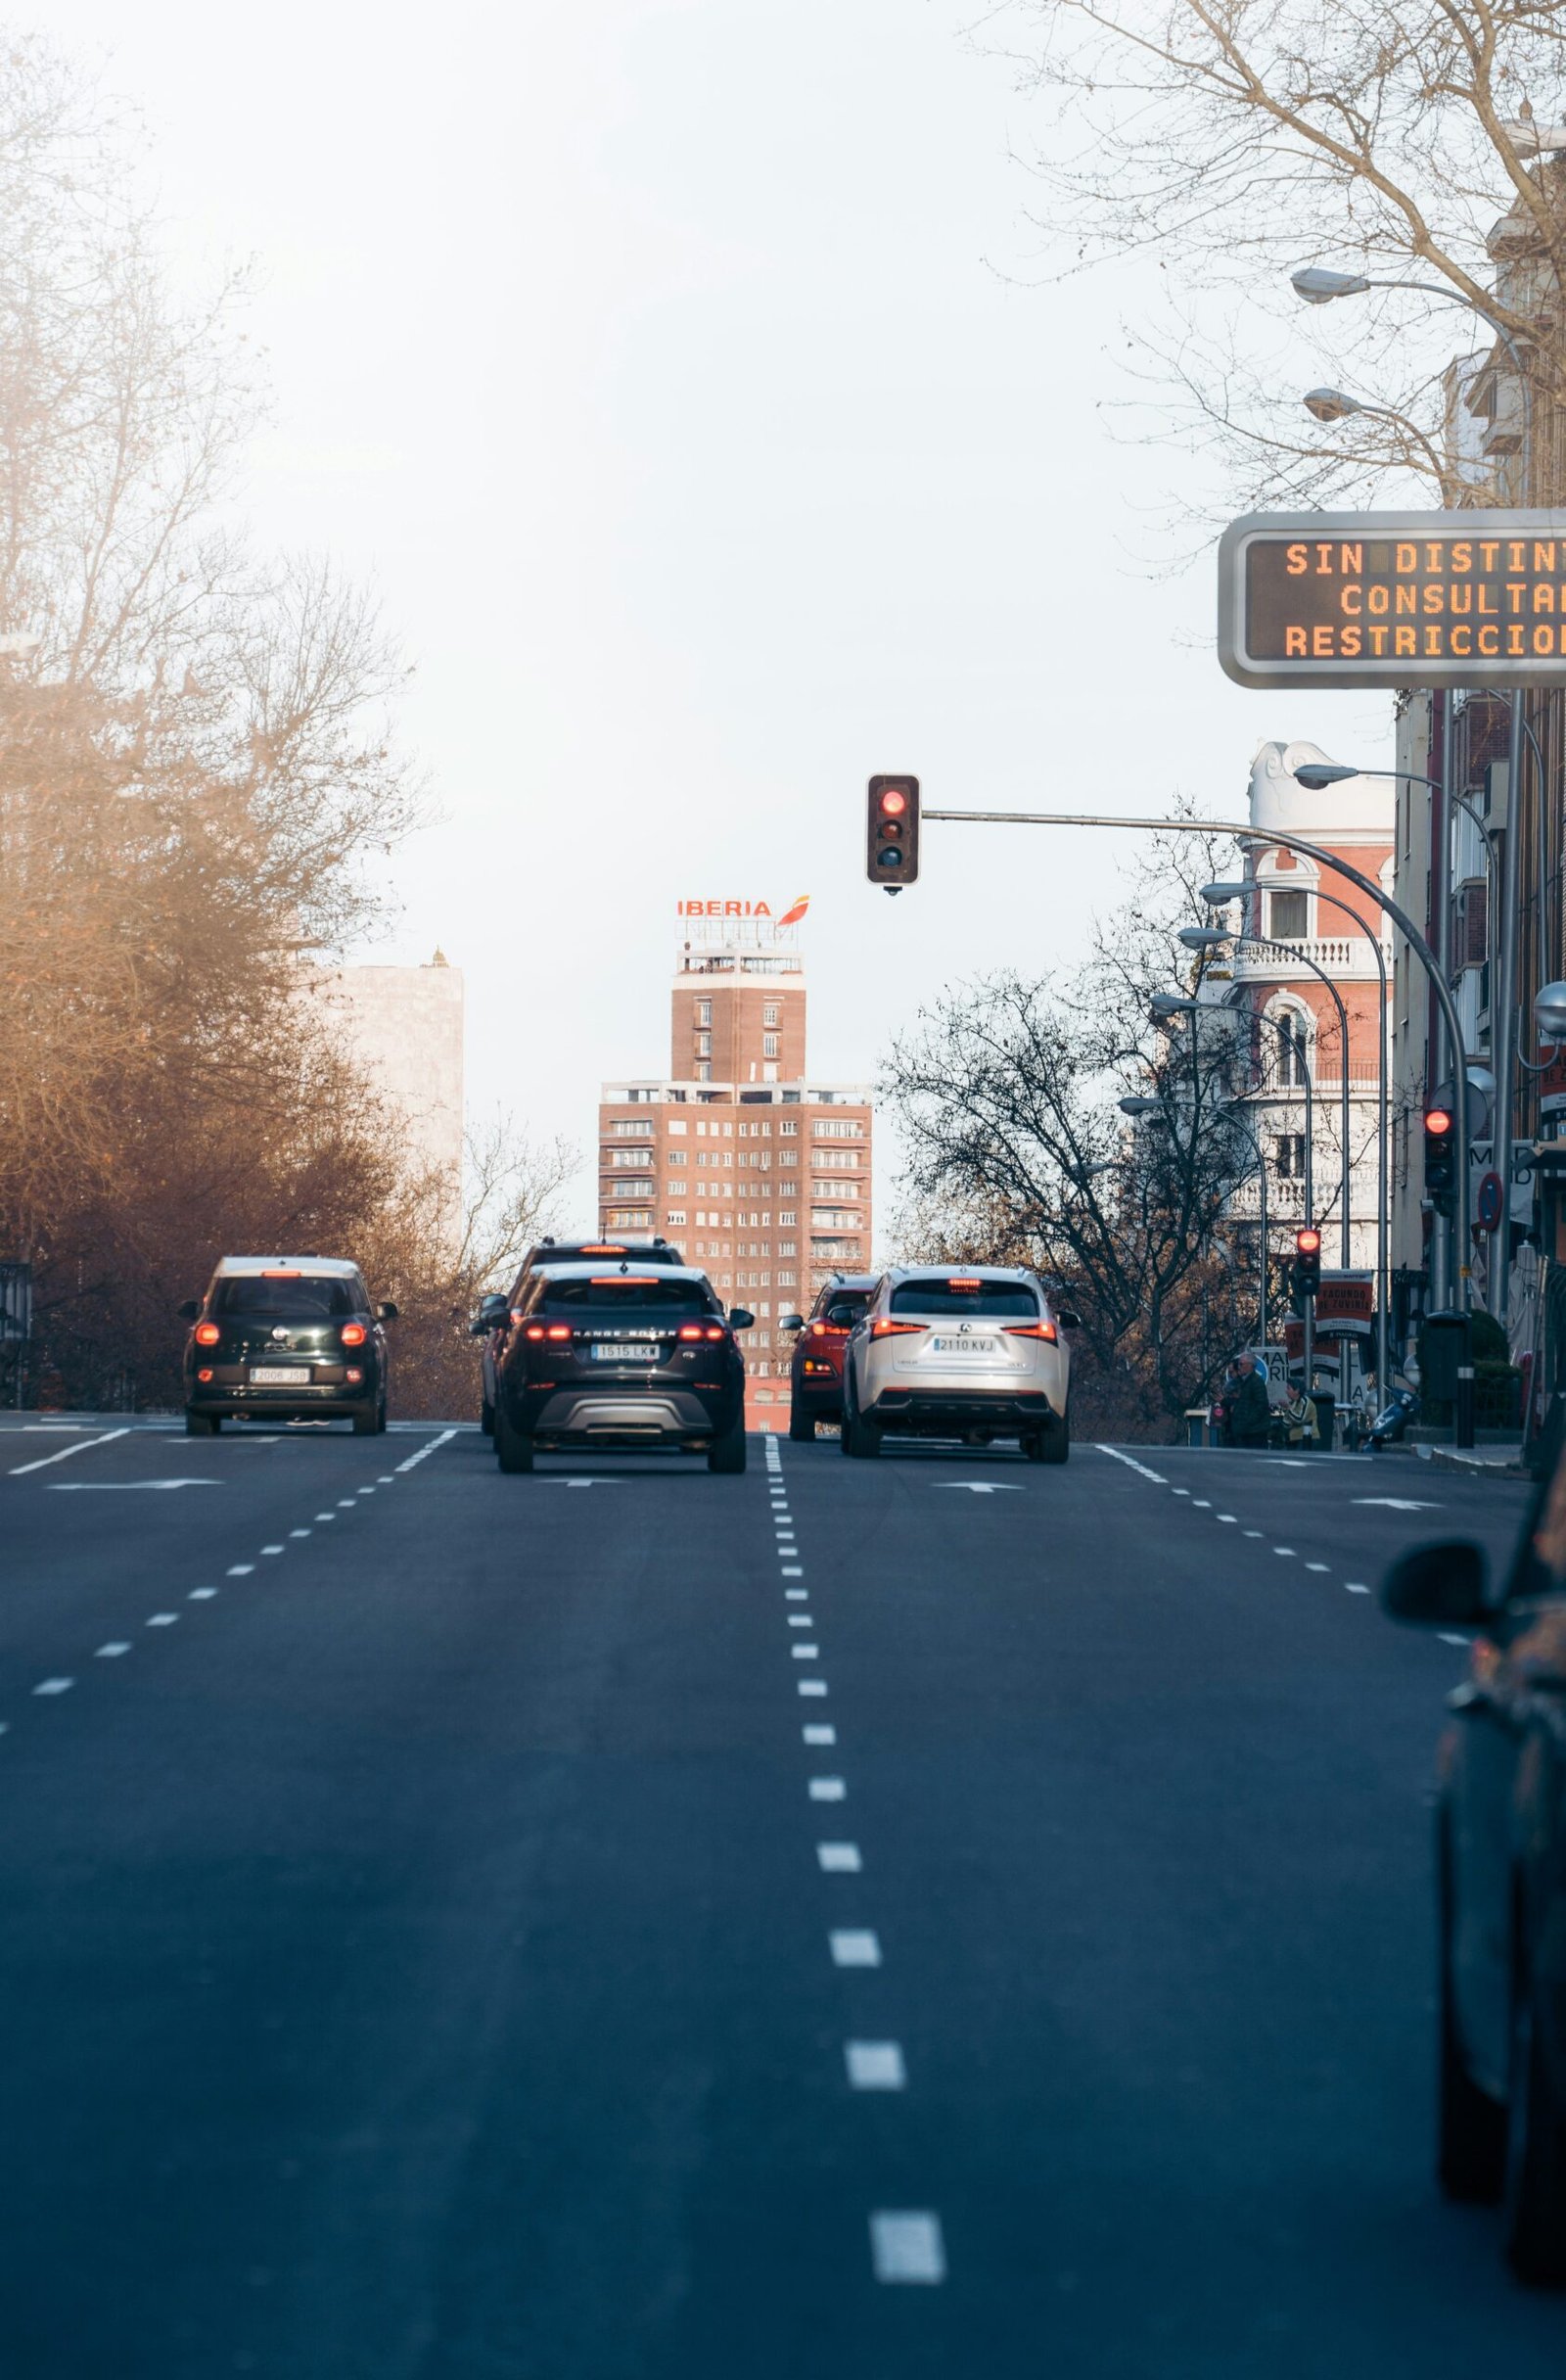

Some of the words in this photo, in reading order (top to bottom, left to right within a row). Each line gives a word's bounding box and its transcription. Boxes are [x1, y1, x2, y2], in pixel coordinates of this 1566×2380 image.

[1286, 543, 1362, 575] SIN
[1396, 541, 1566, 574] DISTIN
[677, 900, 771, 916] IBERIA
[601, 1346, 629, 1357] 1515
[633, 1346, 657, 1357] LKW
[941, 1339, 968, 1351] 2110
[972, 1339, 993, 1351] KVJ
